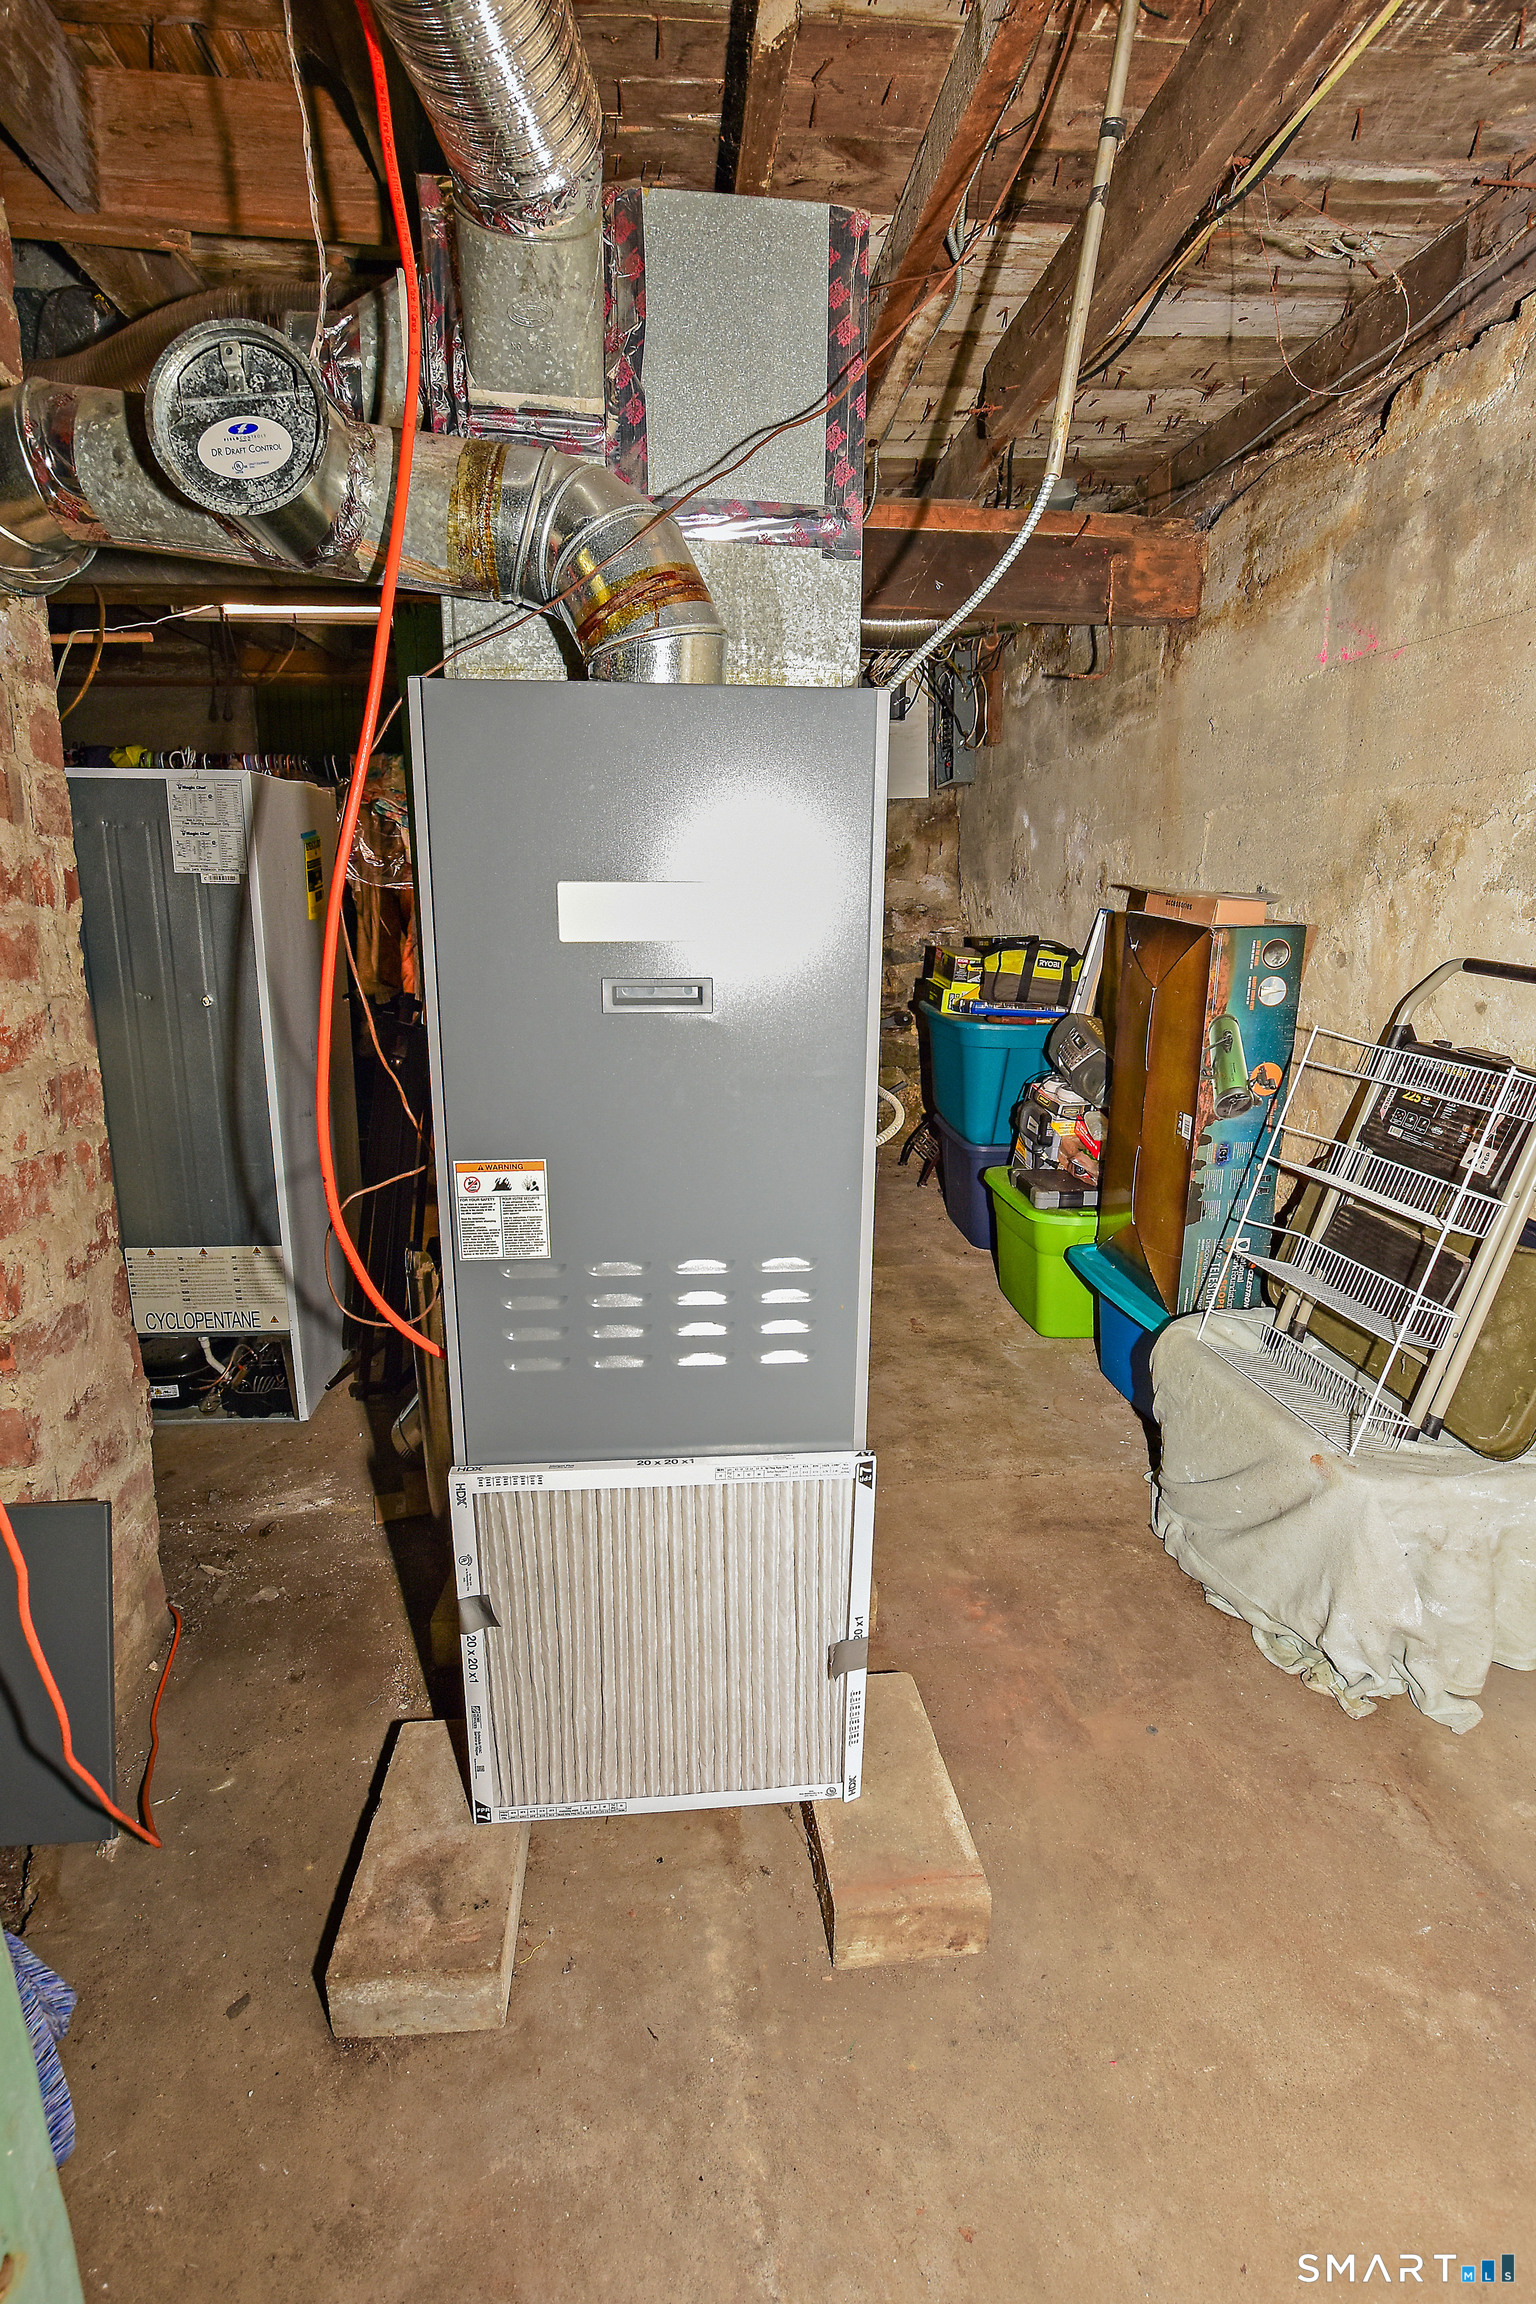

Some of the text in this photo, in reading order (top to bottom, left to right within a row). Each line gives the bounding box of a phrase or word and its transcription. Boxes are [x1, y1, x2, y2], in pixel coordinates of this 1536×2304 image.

[211, 443, 282, 457] DR DRAFT CONTROL
[1165, 899, 1193, 911] accessories
[1039, 959, 1061, 969] RYOBI
[485, 1163, 524, 1171] WARNING
[1479, 1151, 1491, 1170] STEP
[1243, 1269, 1254, 1309] CELESTRON
[146, 1311, 261, 1330] CYCLOPENTANE
[455, 1483, 467, 1506] HDX
[466, 1636, 477, 1648] 20
[468, 1658, 478, 1670] 20
[848, 1775, 857, 1796] HDX
[477, 1813, 491, 1821] 7
